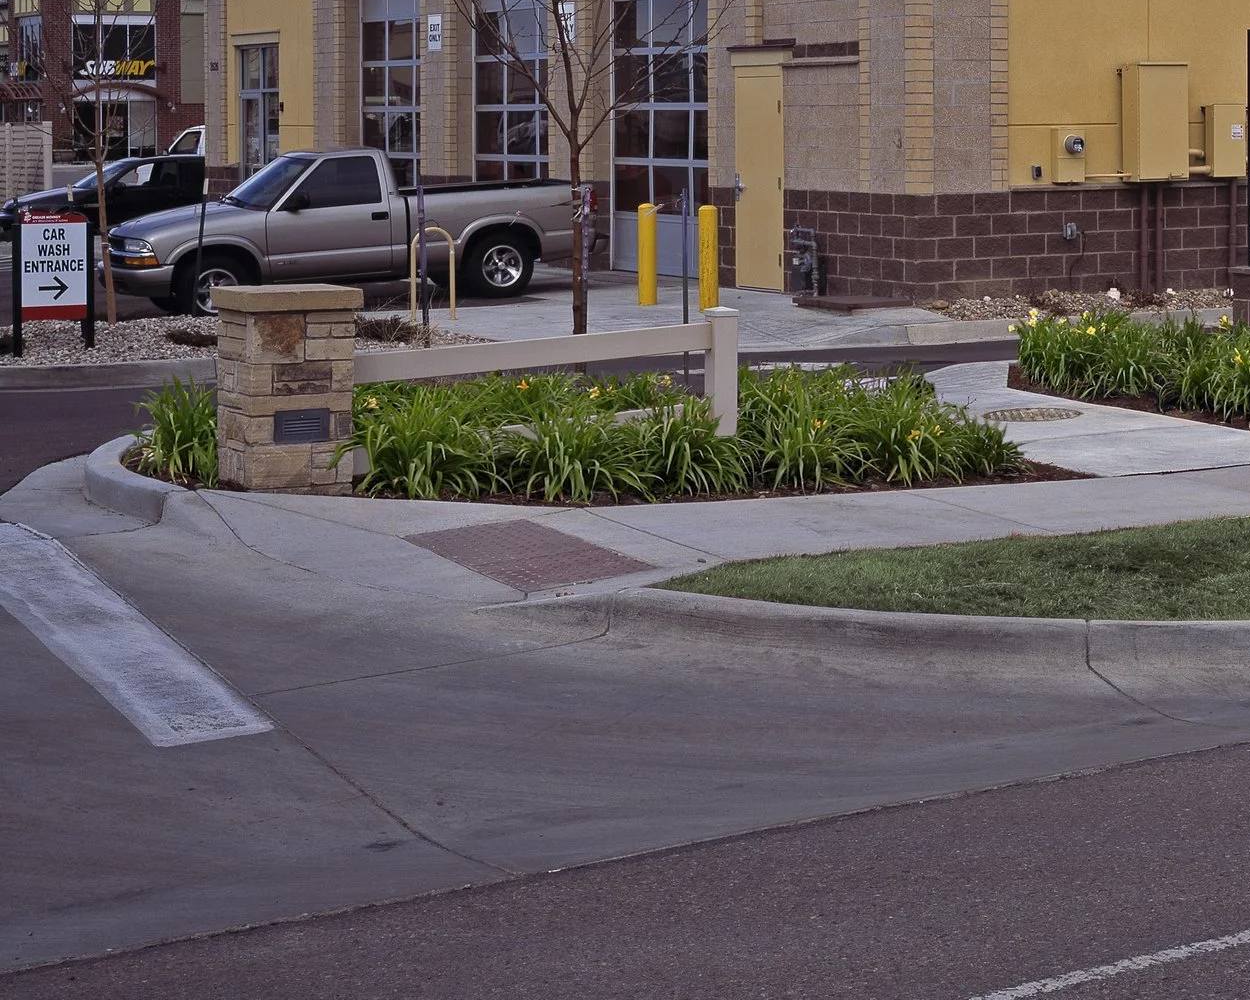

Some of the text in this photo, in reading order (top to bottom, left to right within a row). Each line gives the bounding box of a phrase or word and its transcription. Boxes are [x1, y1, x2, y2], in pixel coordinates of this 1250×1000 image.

[429, 24, 440, 32] EXIT
[428, 34, 441, 42] ONLY
[80, 60, 155, 76] SUBWAY
[42, 228, 65, 240] CAR
[38, 244, 70, 256] WASH
[24, 260, 84, 273] ENTRANCE
